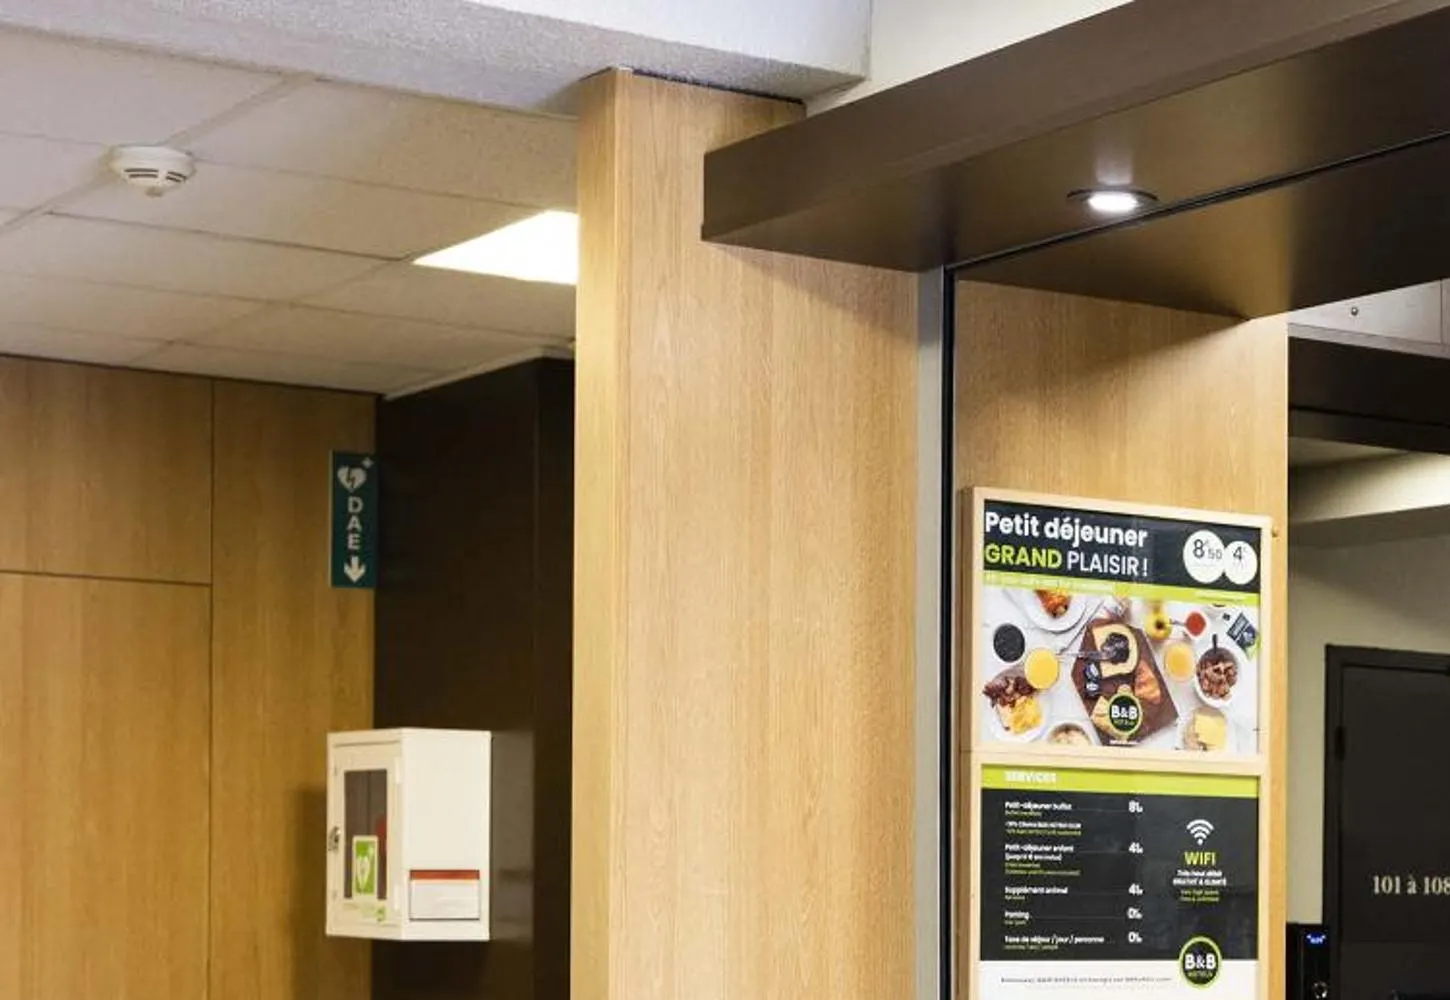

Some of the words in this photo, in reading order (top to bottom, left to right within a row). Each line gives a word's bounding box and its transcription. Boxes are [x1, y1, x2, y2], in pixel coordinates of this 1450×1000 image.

[347, 496, 363, 550] DAE
[985, 512, 1039, 536] Petit
[1044, 517, 1148, 547] déjeuner
[985, 544, 1062, 568] GRAND
[1111, 705, 1138, 720] B&B
[1184, 852, 1216, 865] WIFI
[1373, 875, 1400, 894] 101
[1407, 874, 1416, 894] à
[1184, 953, 1217, 971] B&B
